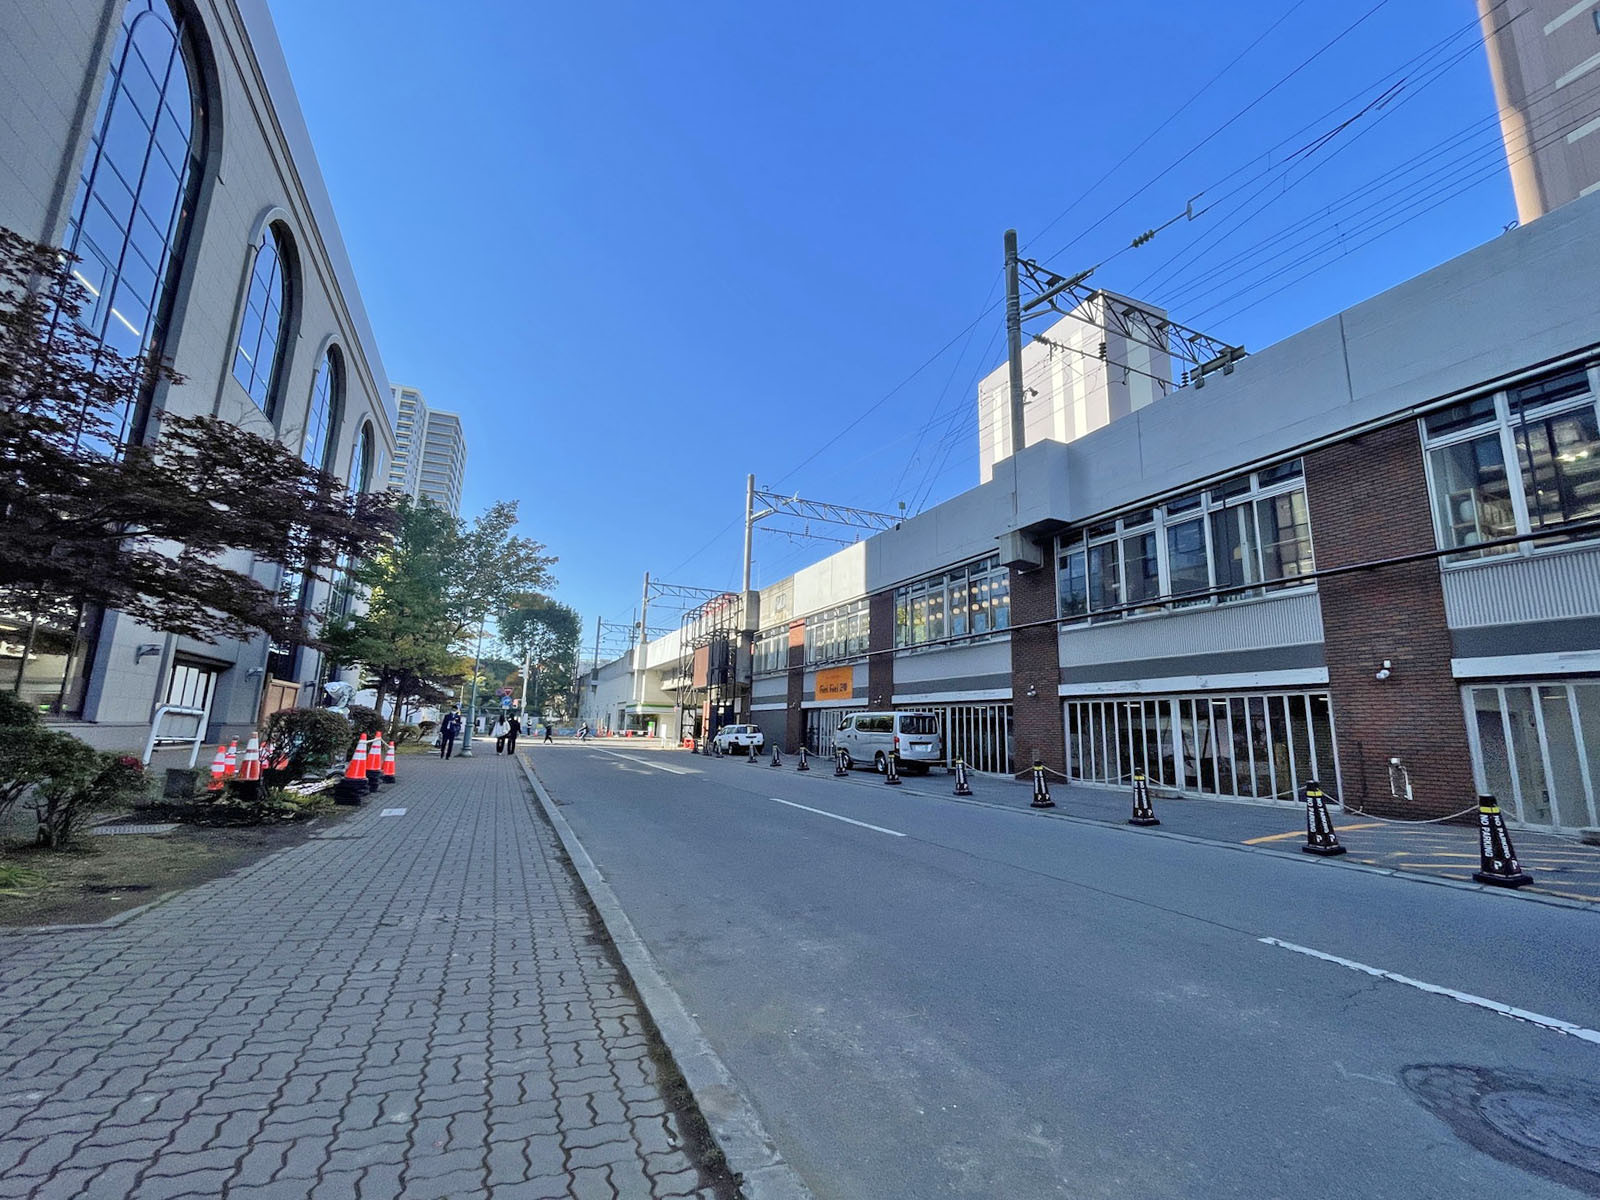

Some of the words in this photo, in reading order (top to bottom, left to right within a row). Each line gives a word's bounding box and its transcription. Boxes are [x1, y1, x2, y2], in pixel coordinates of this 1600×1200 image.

[1480, 814, 1490, 825] NO
[1494, 816, 1502, 826] NO
[1482, 826, 1494, 857] PARKING
[1497, 828, 1510, 858] PARKING
